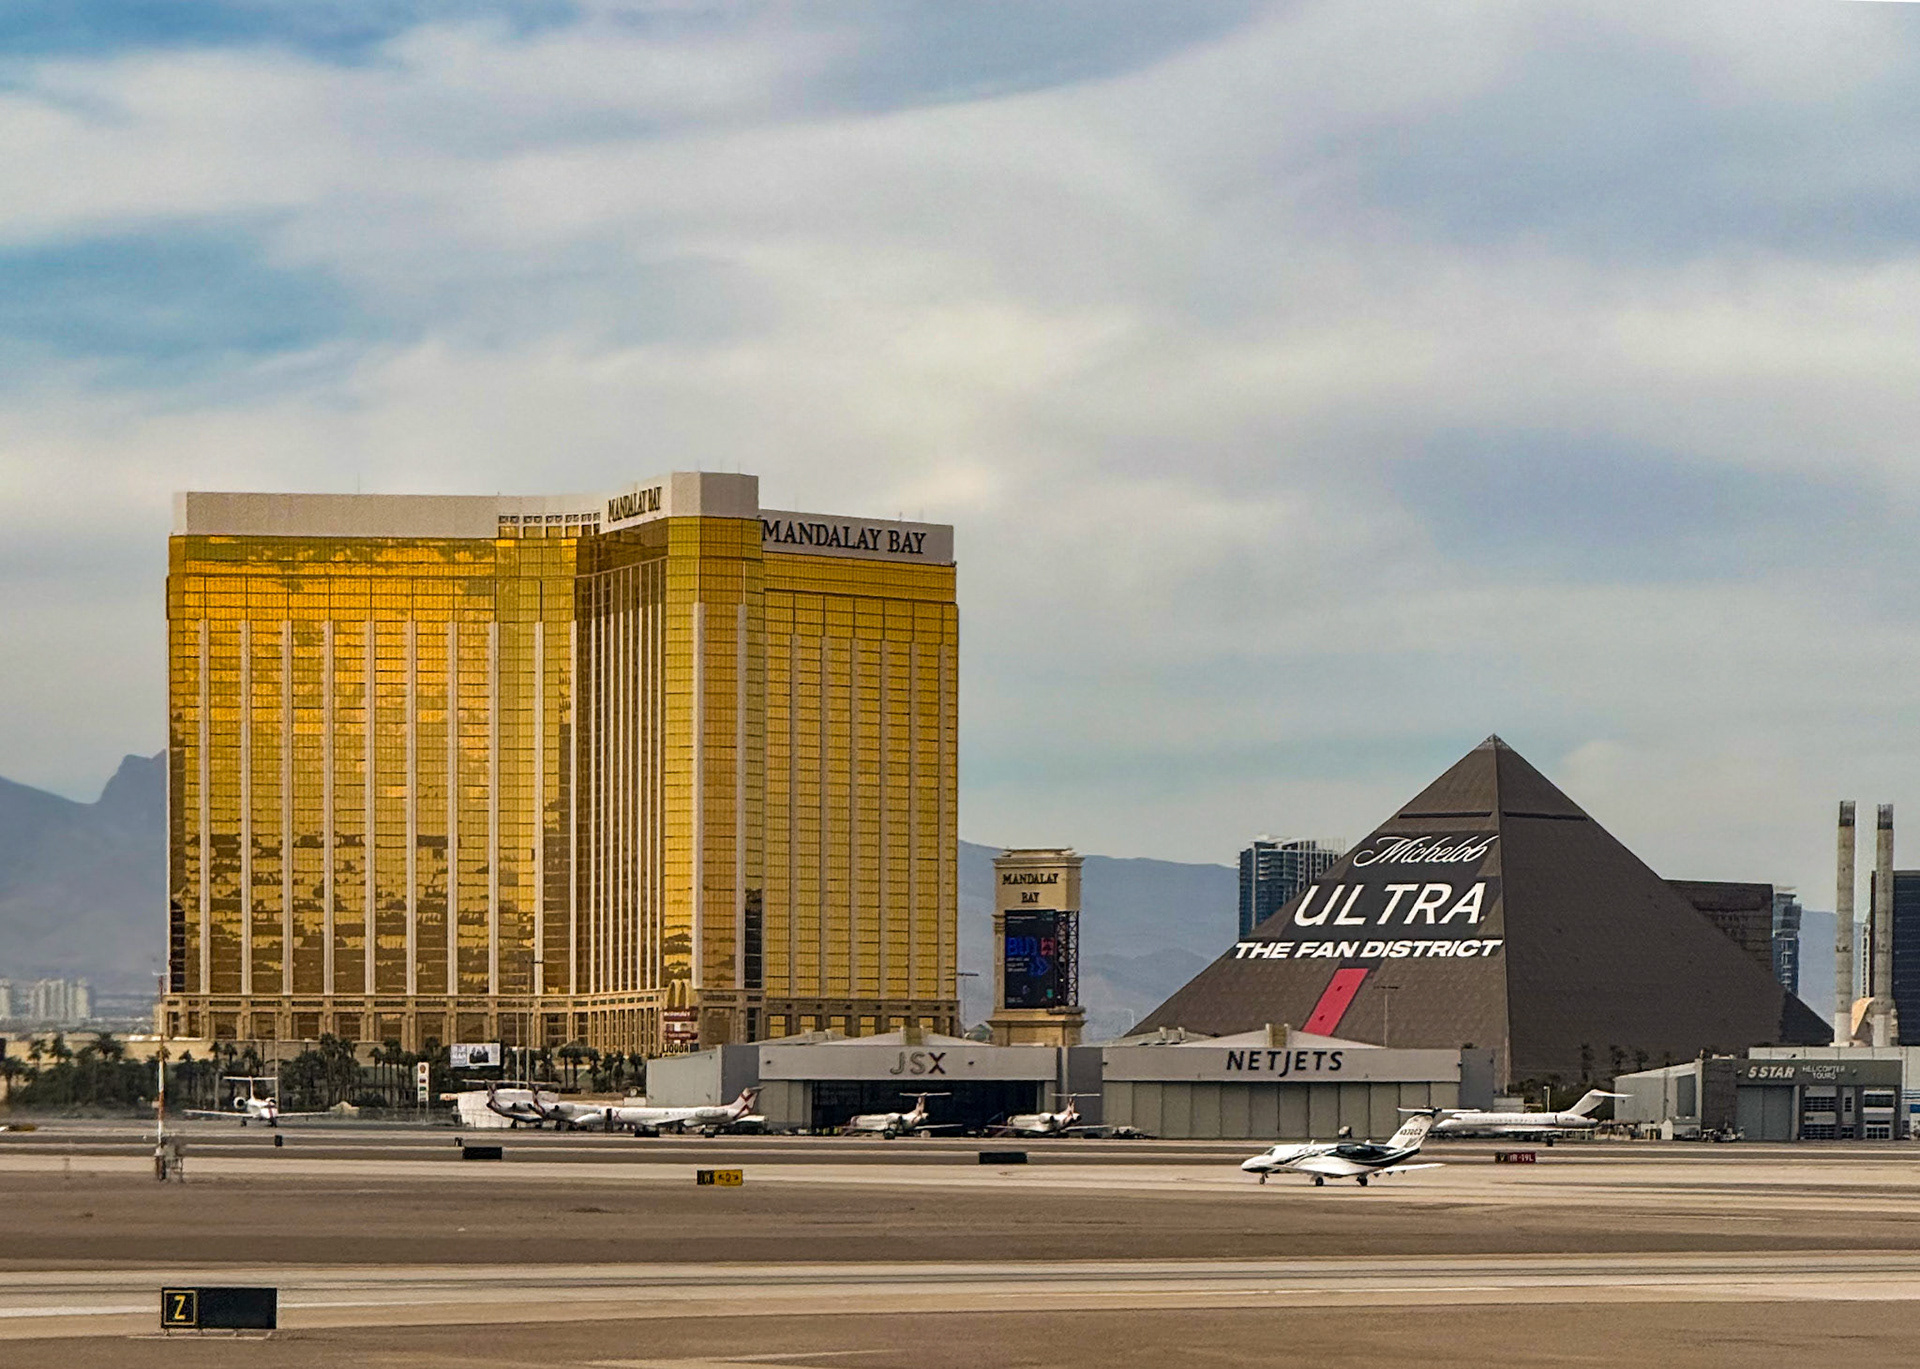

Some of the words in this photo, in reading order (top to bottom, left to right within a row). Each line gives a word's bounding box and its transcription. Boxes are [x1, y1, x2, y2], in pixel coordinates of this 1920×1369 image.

[608, 489, 647, 523] MANDALAY
[648, 486, 662, 511] BAY
[762, 518, 882, 551] MANDALAY
[887, 529, 927, 554] BAY
[1353, 835, 1499, 867] Michelob
[1002, 873, 1059, 885] MANDALAY
[1021, 892, 1040, 903] BAY
[1294, 882, 1487, 927] ULTRA
[1235, 941, 1295, 959] THE
[1294, 941, 1359, 959] FAN
[1360, 940, 1503, 958] DISTRICT
[890, 1051, 946, 1075] JSX
[1226, 1051, 1343, 1077] NETJETS
[1758, 1066, 1795, 1078] STAR
[174, 1295, 186, 1320] Z
